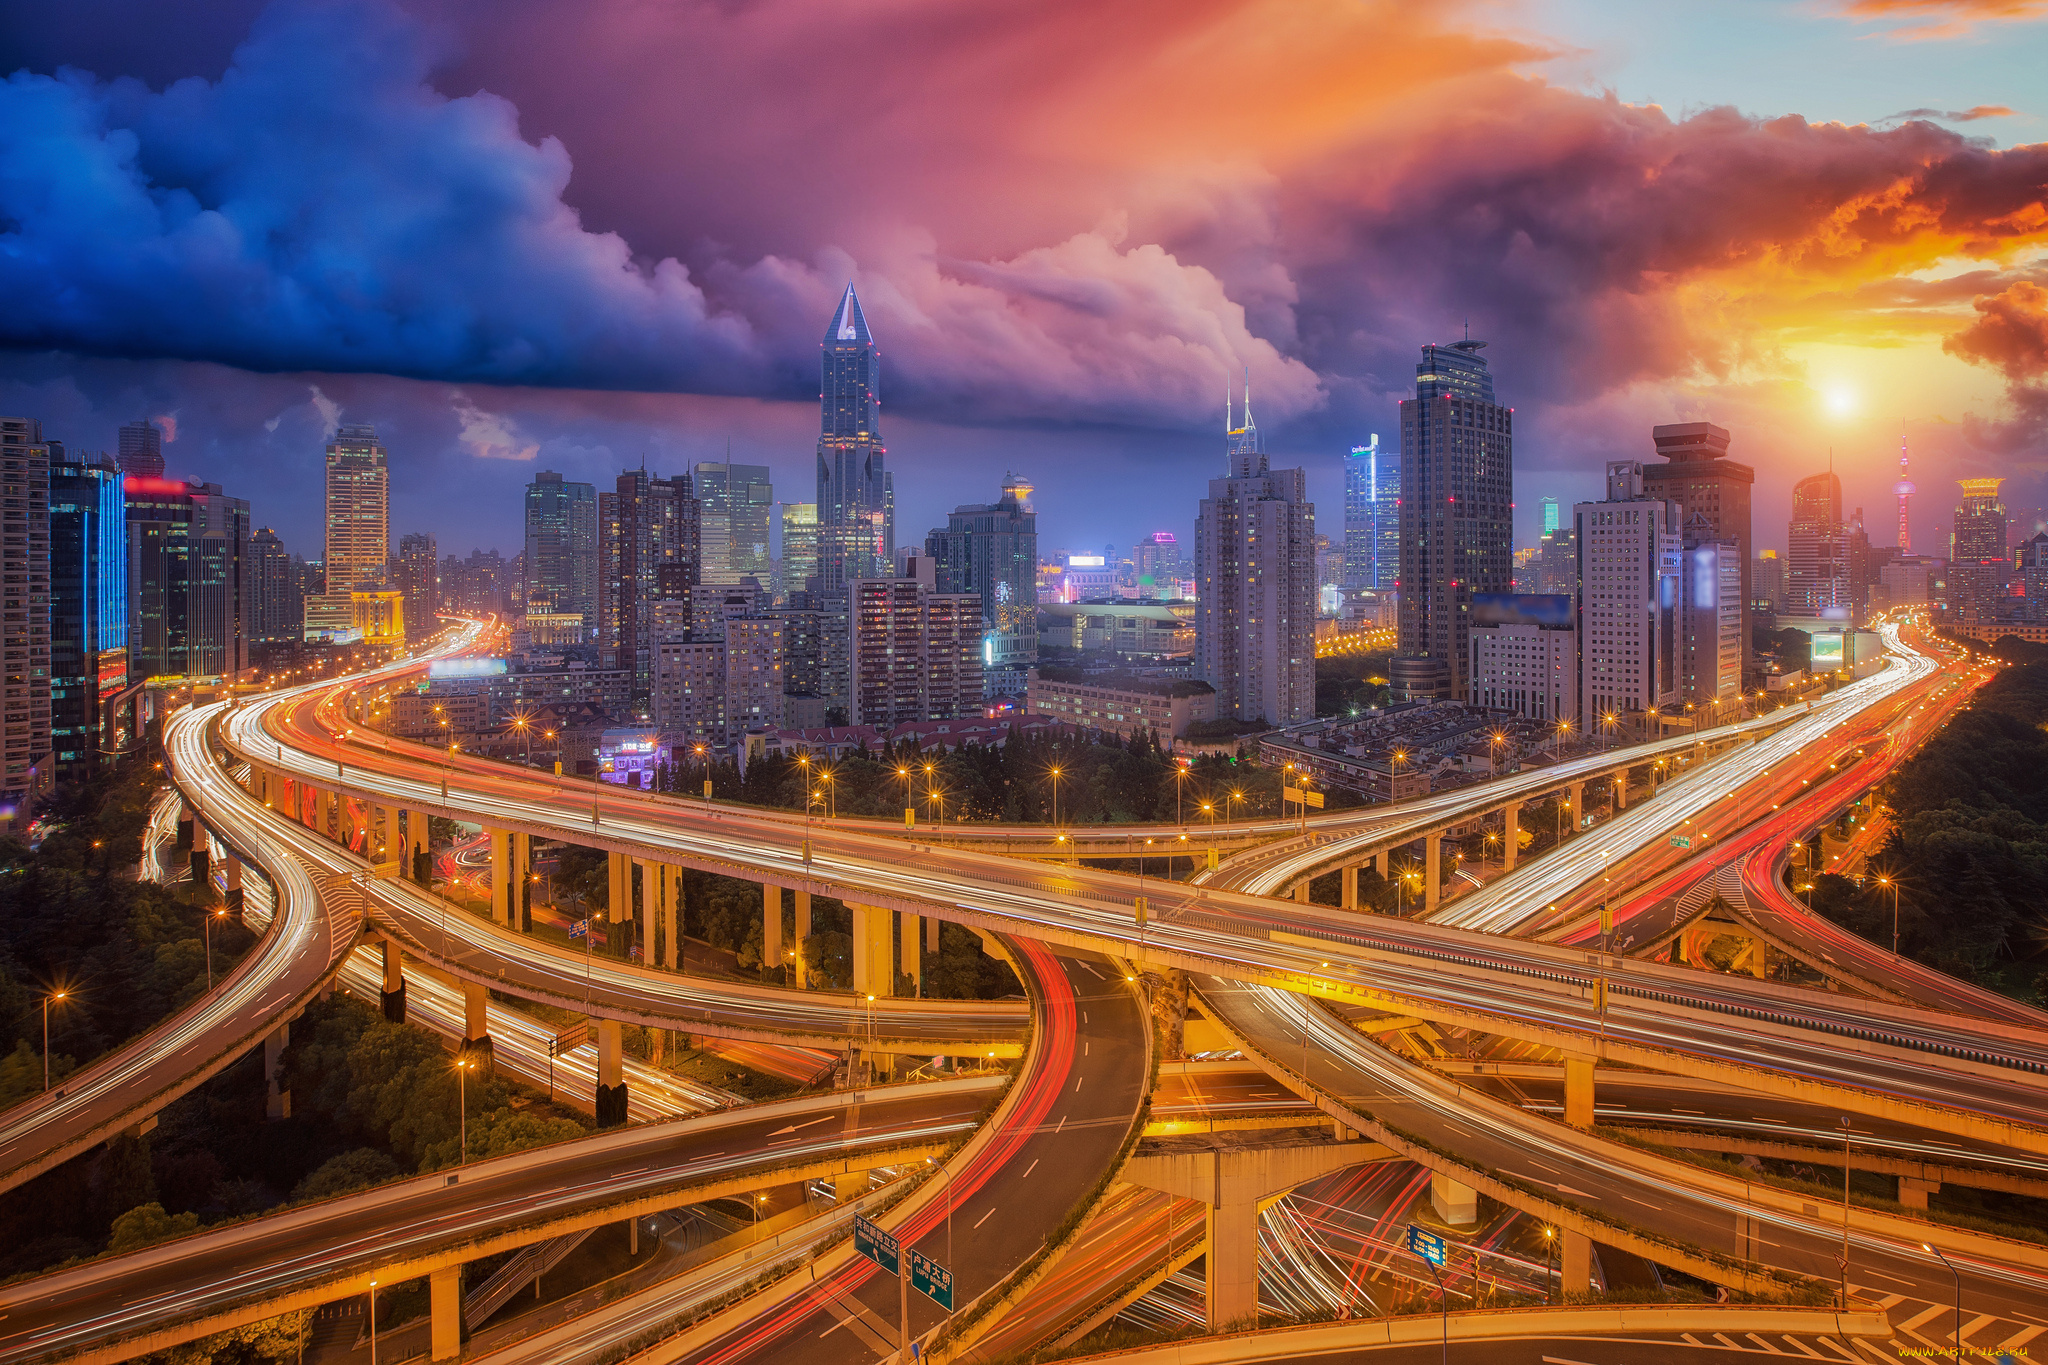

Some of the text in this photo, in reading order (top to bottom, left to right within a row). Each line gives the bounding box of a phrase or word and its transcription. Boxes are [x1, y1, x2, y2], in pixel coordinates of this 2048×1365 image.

[856, 1217, 897, 1252] 共和新路立交
[914, 1255, 950, 1285] 卢浦大桥
[916, 1266, 948, 1292] LUPU BRIDGE
